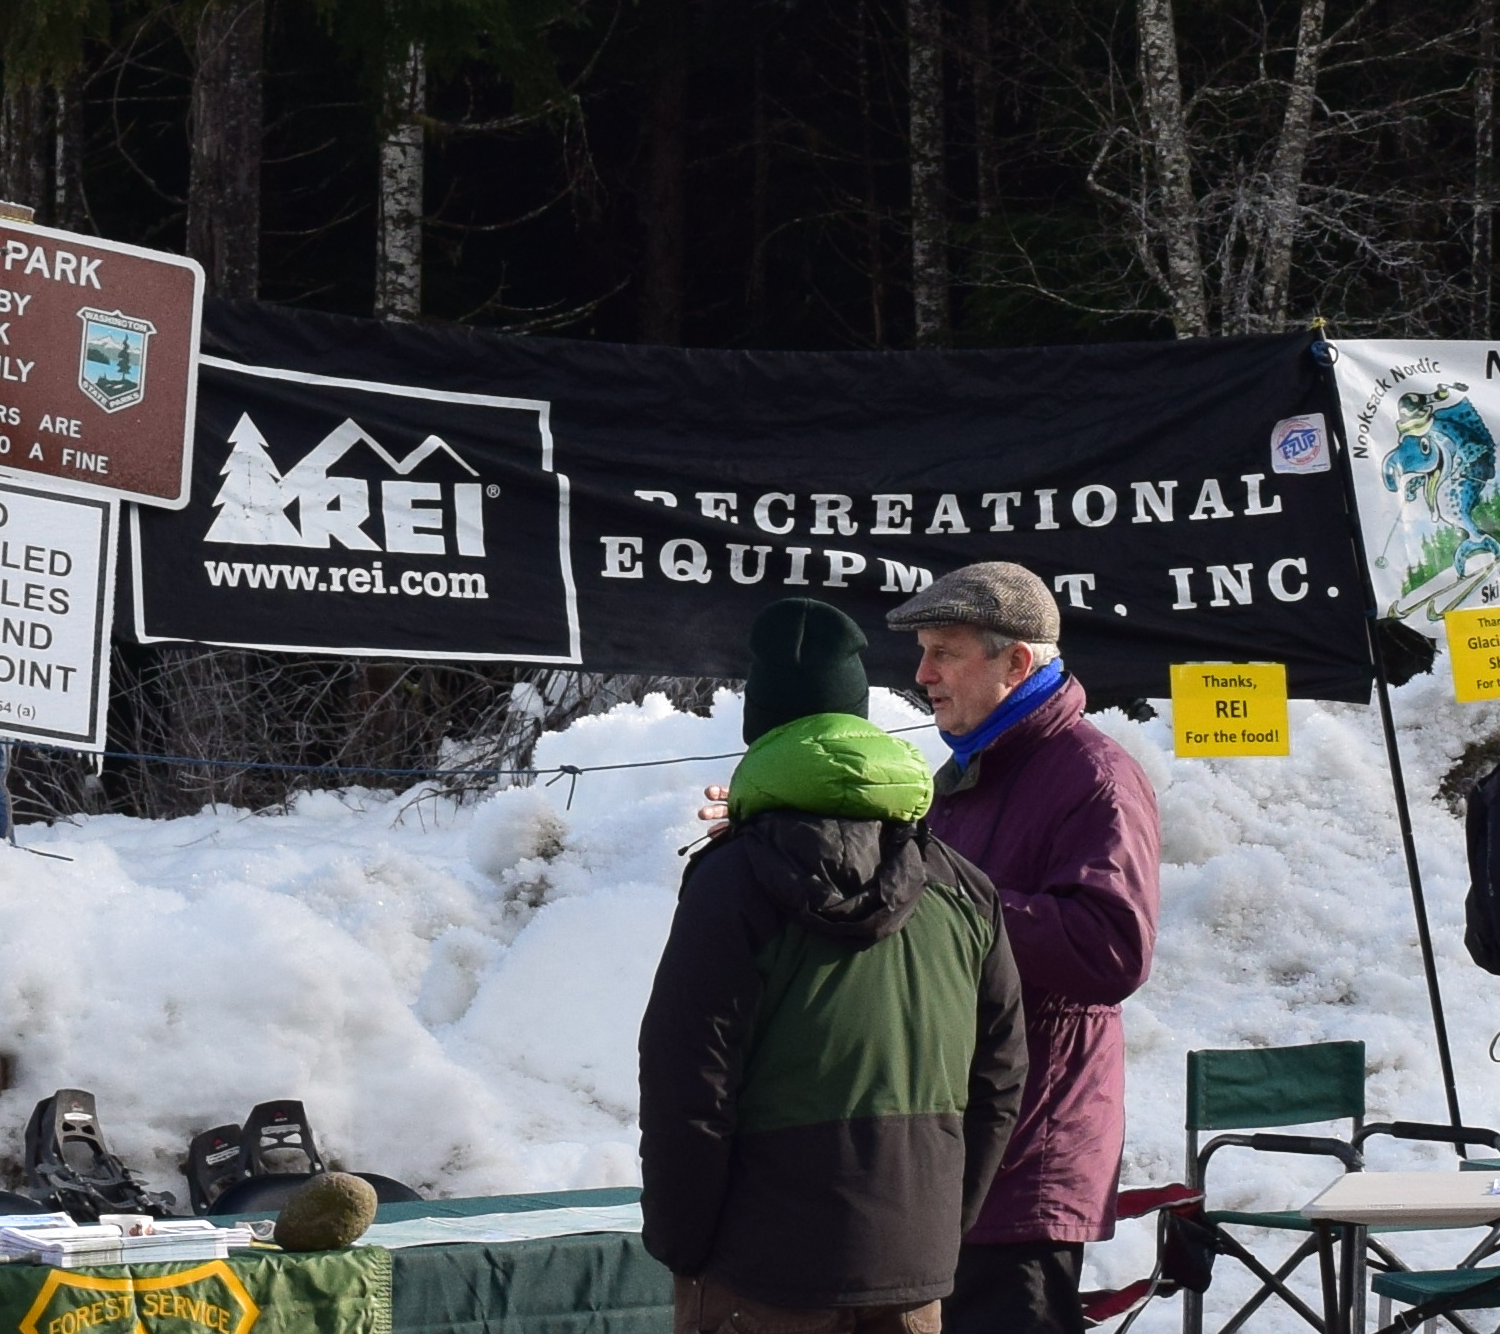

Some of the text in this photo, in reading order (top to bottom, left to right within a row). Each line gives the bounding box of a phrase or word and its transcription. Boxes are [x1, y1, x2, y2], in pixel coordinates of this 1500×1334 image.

[85, 311, 147, 332] WASHINGTON
[82, 380, 140, 407] STATE PARKS
[1353, 357, 1441, 459] Nooksack Nordic
[39, 414, 82, 438] ARE
[29, 443, 43, 461] A
[62, 448, 109, 475] FINE
[204, 560, 489, 600] www.rei.com
[600, 535, 1340, 617] EQUIPMT, INC.
[1481, 584, 1500, 604] Ski
[1202, 674, 1258, 692] Thanks,
[1476, 679, 1494, 690] For
[16, 703, 37, 721] (a)
[1216, 700, 1248, 719] REI
[1185, 729, 1279, 745] For the food!
[143, 1294, 231, 1334] SERVICE
